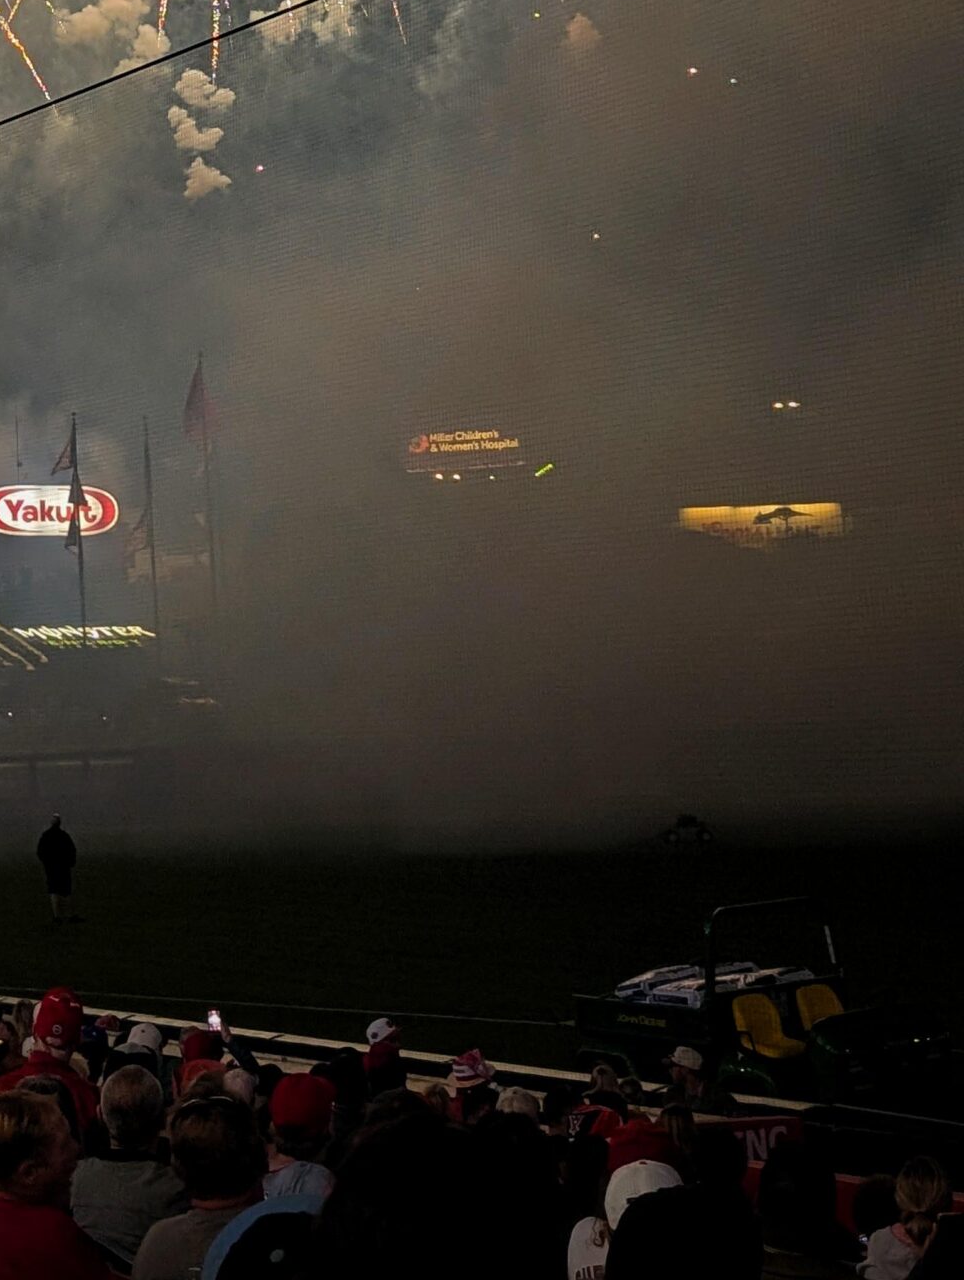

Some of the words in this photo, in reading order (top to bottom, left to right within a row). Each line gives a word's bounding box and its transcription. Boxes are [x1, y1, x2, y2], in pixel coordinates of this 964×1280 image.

[455, 429, 499, 441] Children's
[430, 443, 438, 452] &
[439, 441, 479, 452] Women's
[480, 438, 518, 451] Hospital
[4, 499, 97, 523] Yakut
